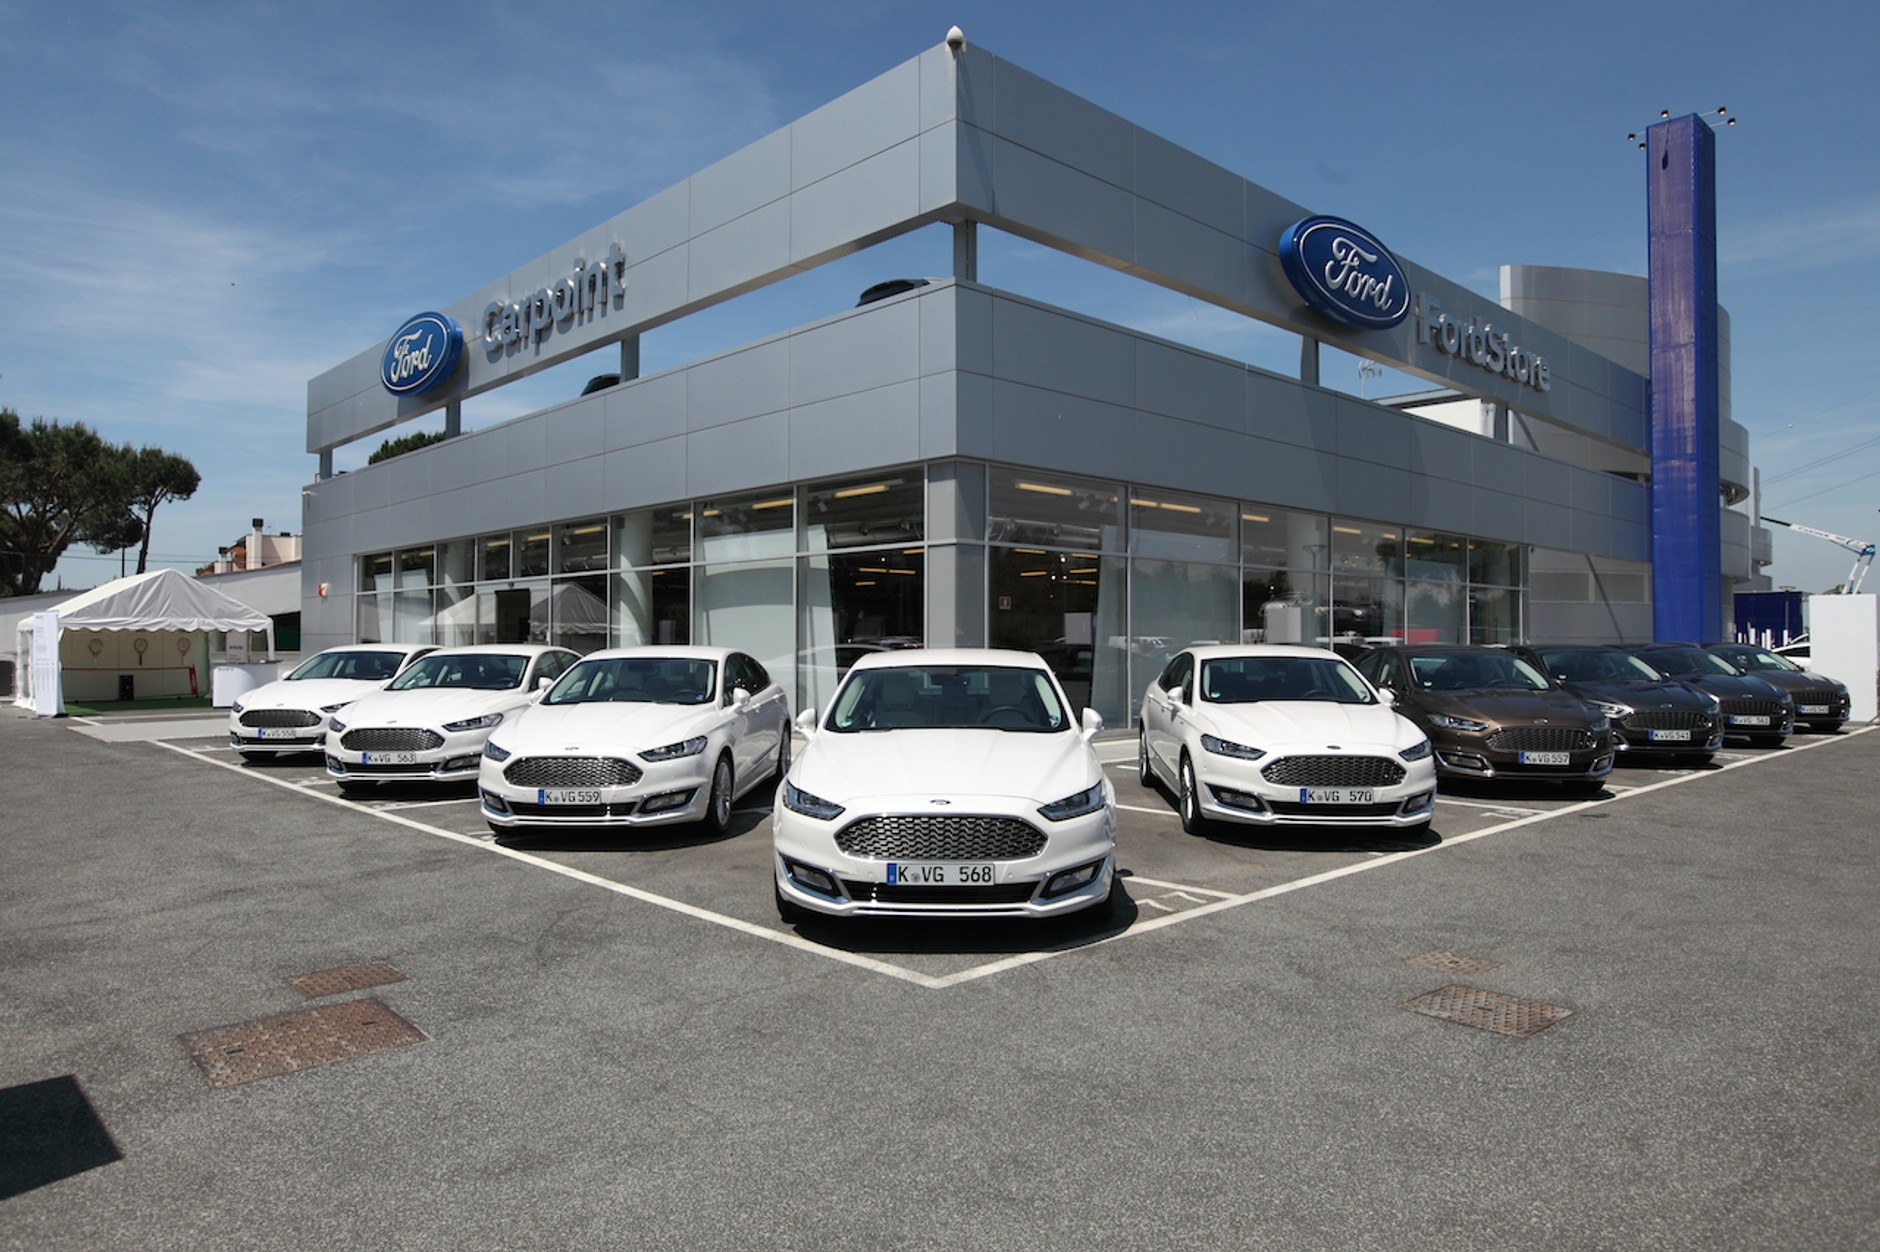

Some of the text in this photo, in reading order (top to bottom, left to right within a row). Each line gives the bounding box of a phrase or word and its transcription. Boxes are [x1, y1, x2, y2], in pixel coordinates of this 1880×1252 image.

[1324, 236, 1393, 311] Ford
[481, 242, 627, 353] Carpoint
[389, 328, 433, 383] Ford
[1415, 291, 1552, 393] FordStore
[379, 753, 391, 763] VG
[397, 753, 414, 763] 563
[545, 791, 600, 803] K VG 559
[1308, 790, 1372, 803] K VG 570
[898, 865, 992, 883] K VG 568
